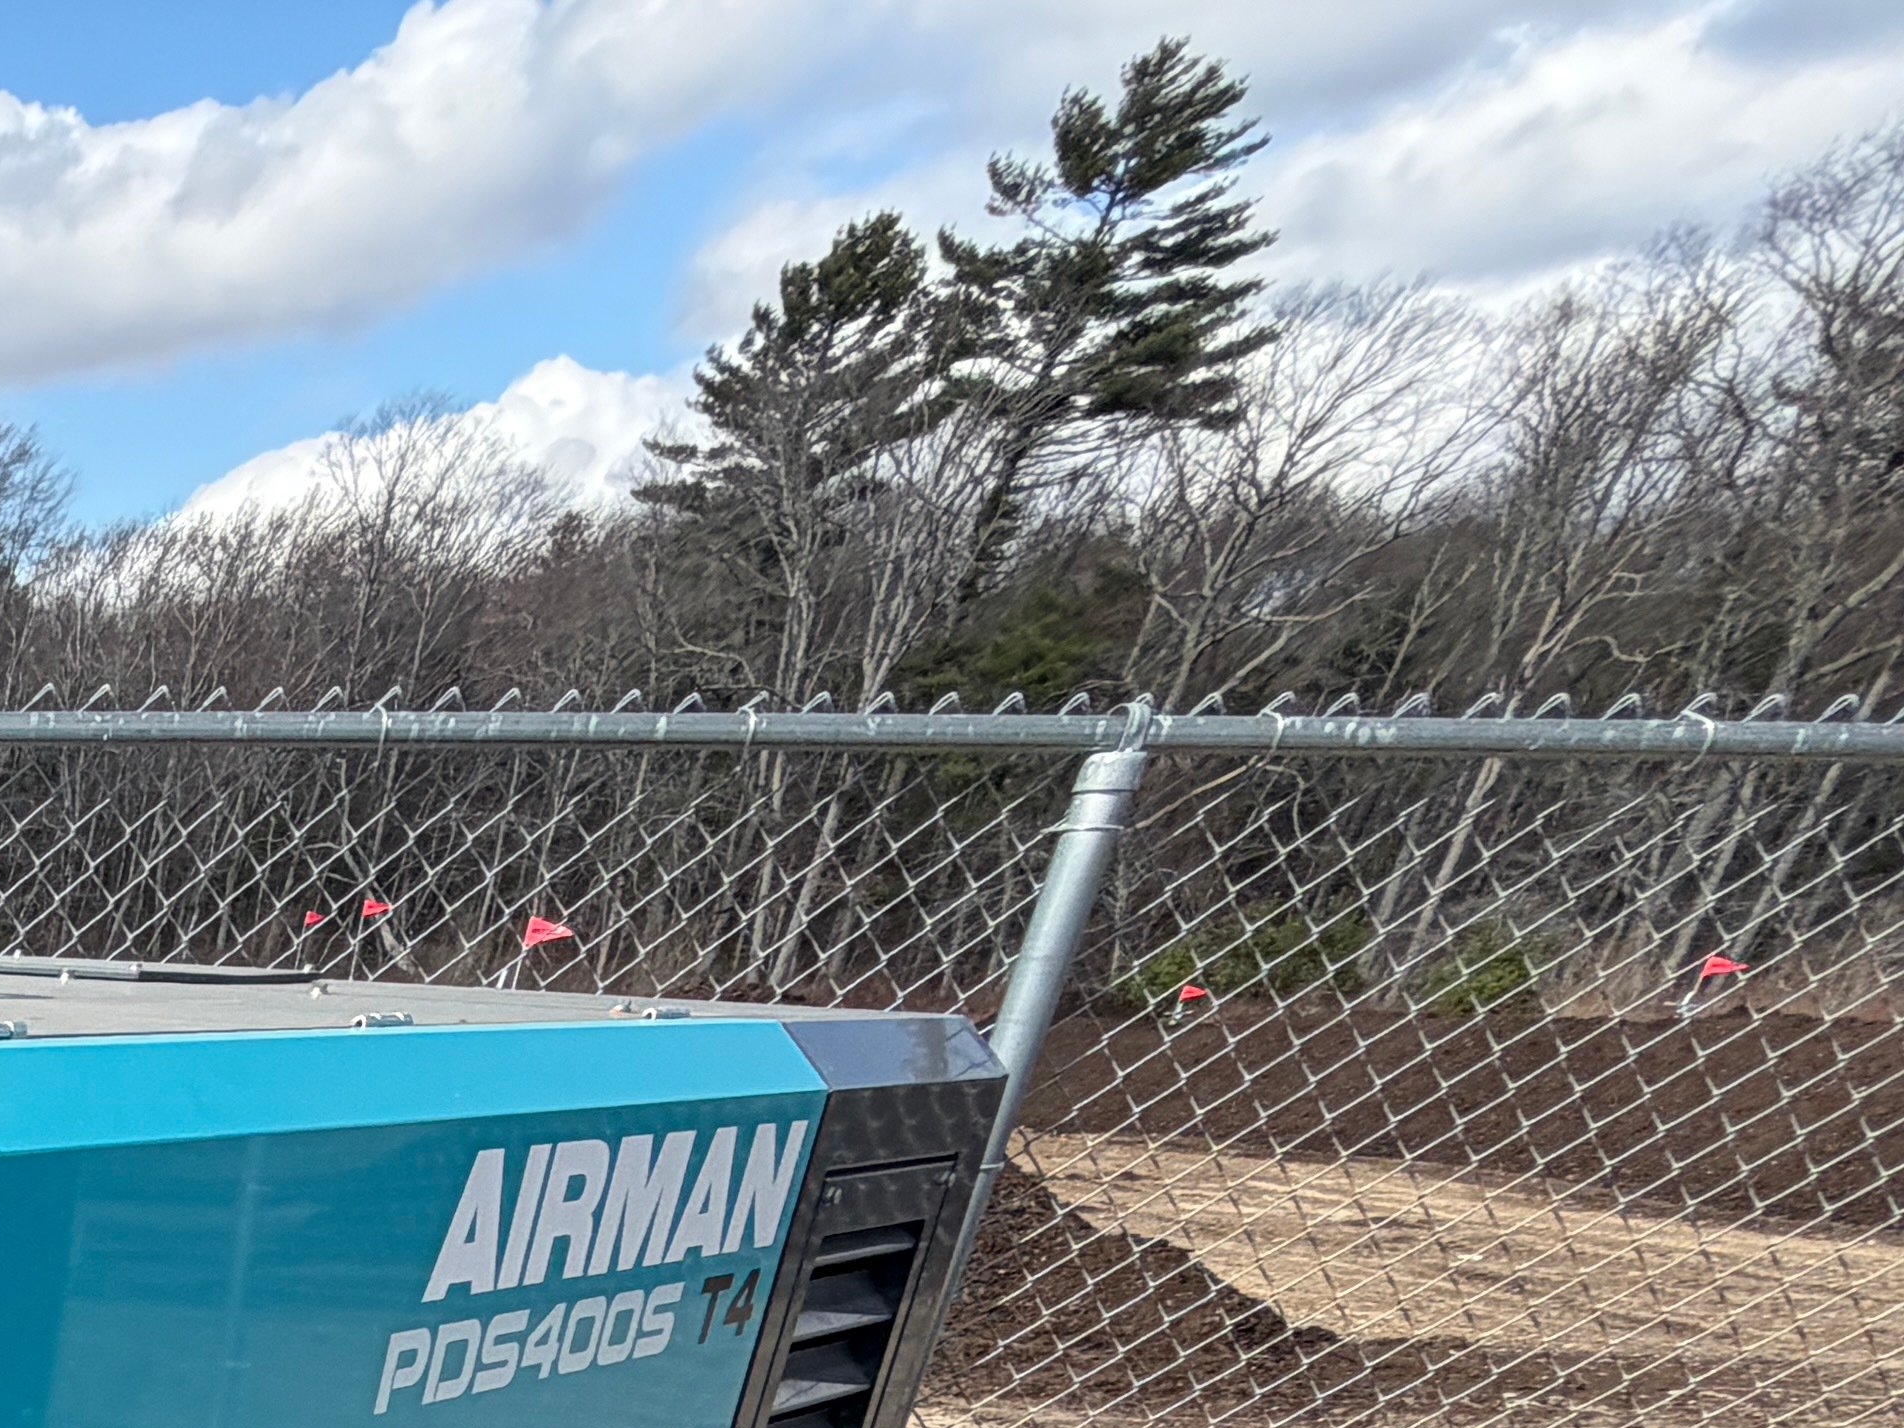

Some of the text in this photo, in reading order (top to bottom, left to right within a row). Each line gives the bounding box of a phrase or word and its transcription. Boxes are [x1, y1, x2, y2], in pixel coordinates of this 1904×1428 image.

[421, 1120, 809, 1303] AIRMAN
[373, 1268, 761, 1415] PDS400S T4
